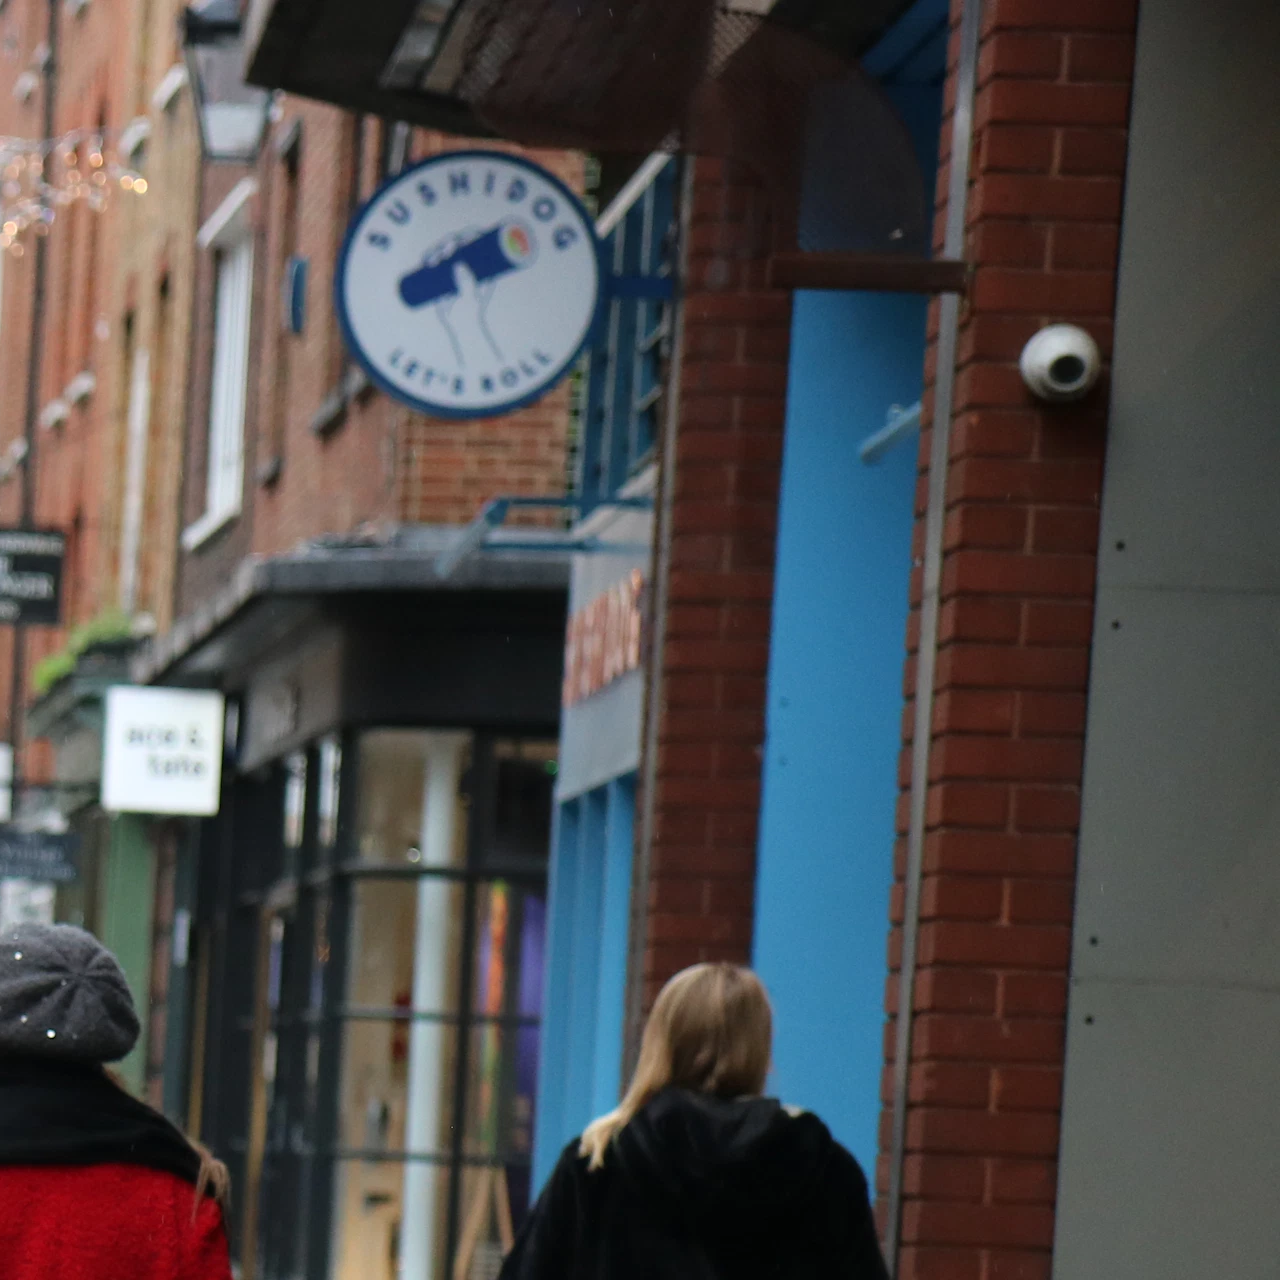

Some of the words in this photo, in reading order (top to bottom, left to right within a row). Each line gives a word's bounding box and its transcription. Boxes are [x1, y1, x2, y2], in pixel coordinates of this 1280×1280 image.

[366, 168, 578, 251] SUSHIDOG
[388, 347, 464, 395] LET'S
[480, 350, 553, 395] ROLL
[124, 726, 178, 749] ace
[148, 754, 205, 779] tate
